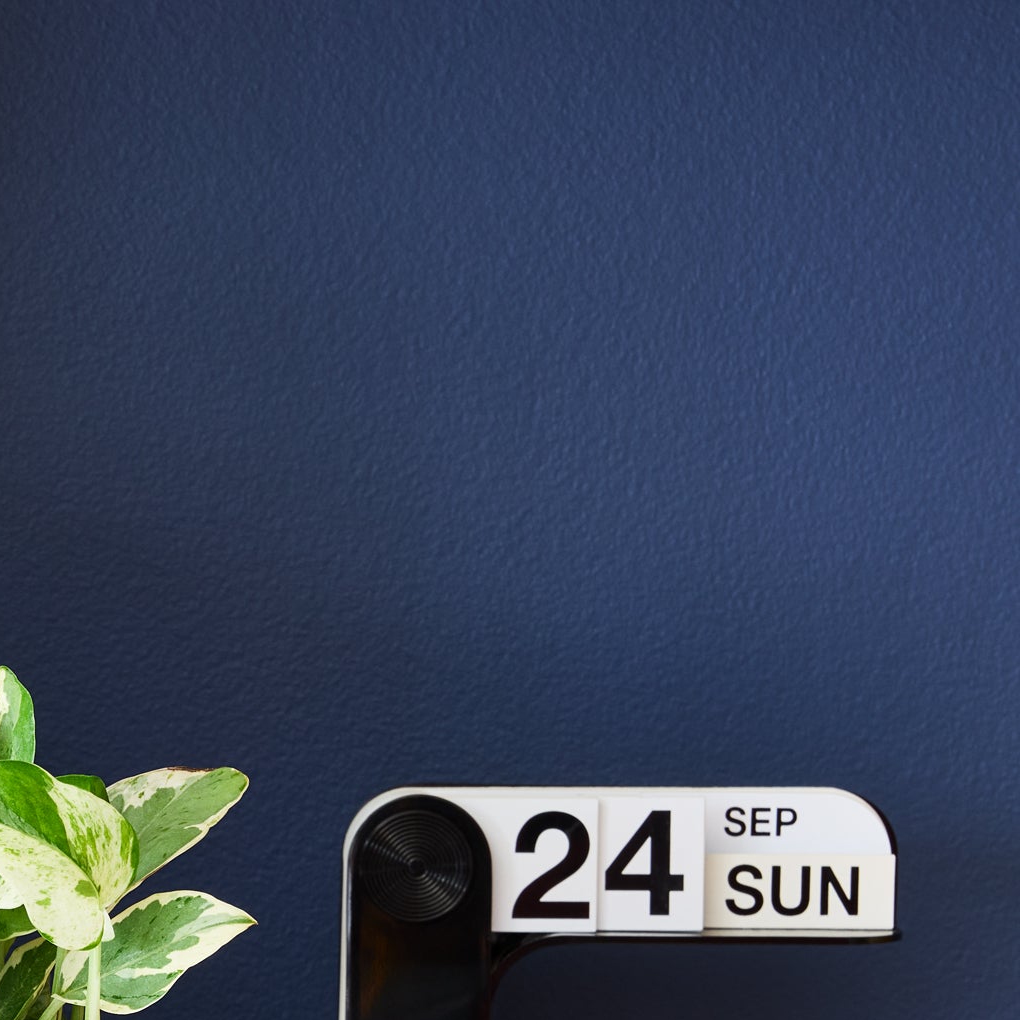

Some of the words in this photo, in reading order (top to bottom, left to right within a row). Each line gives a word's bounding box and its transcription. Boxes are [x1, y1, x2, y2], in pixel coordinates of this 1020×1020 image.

[724, 807, 797, 837] SEP
[512, 810, 684, 919] 24
[725, 864, 859, 916] SUN
